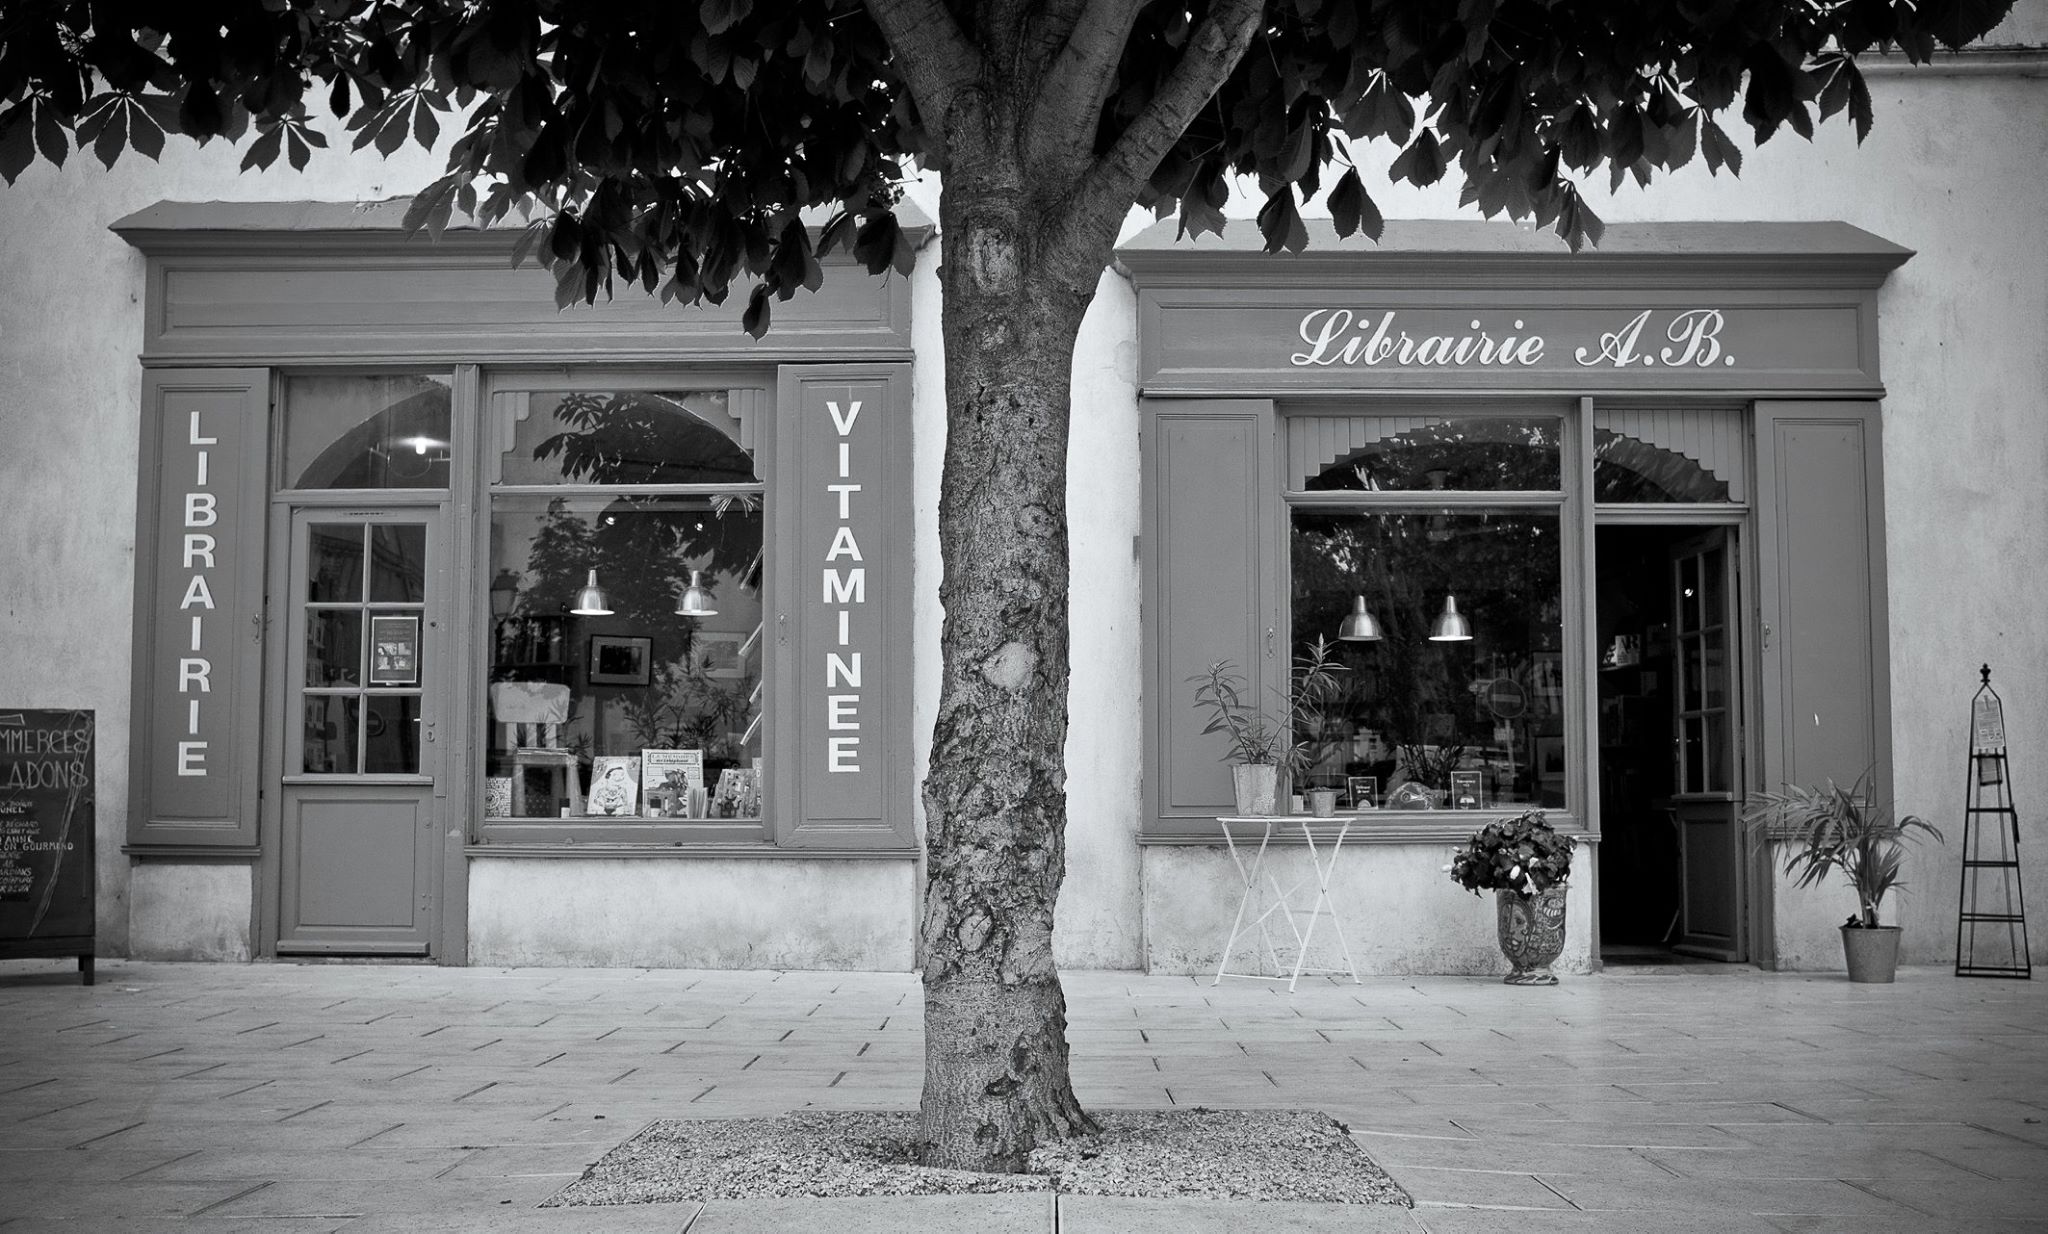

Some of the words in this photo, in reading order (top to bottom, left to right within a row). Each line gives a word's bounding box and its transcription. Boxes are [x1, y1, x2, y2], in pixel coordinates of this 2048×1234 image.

[1289, 308, 1546, 368] Librairie
[1574, 309, 1736, 369] A.B.
[177, 410, 218, 777] LIBRAIRIE
[822, 400, 866, 774] VITAMINEE
